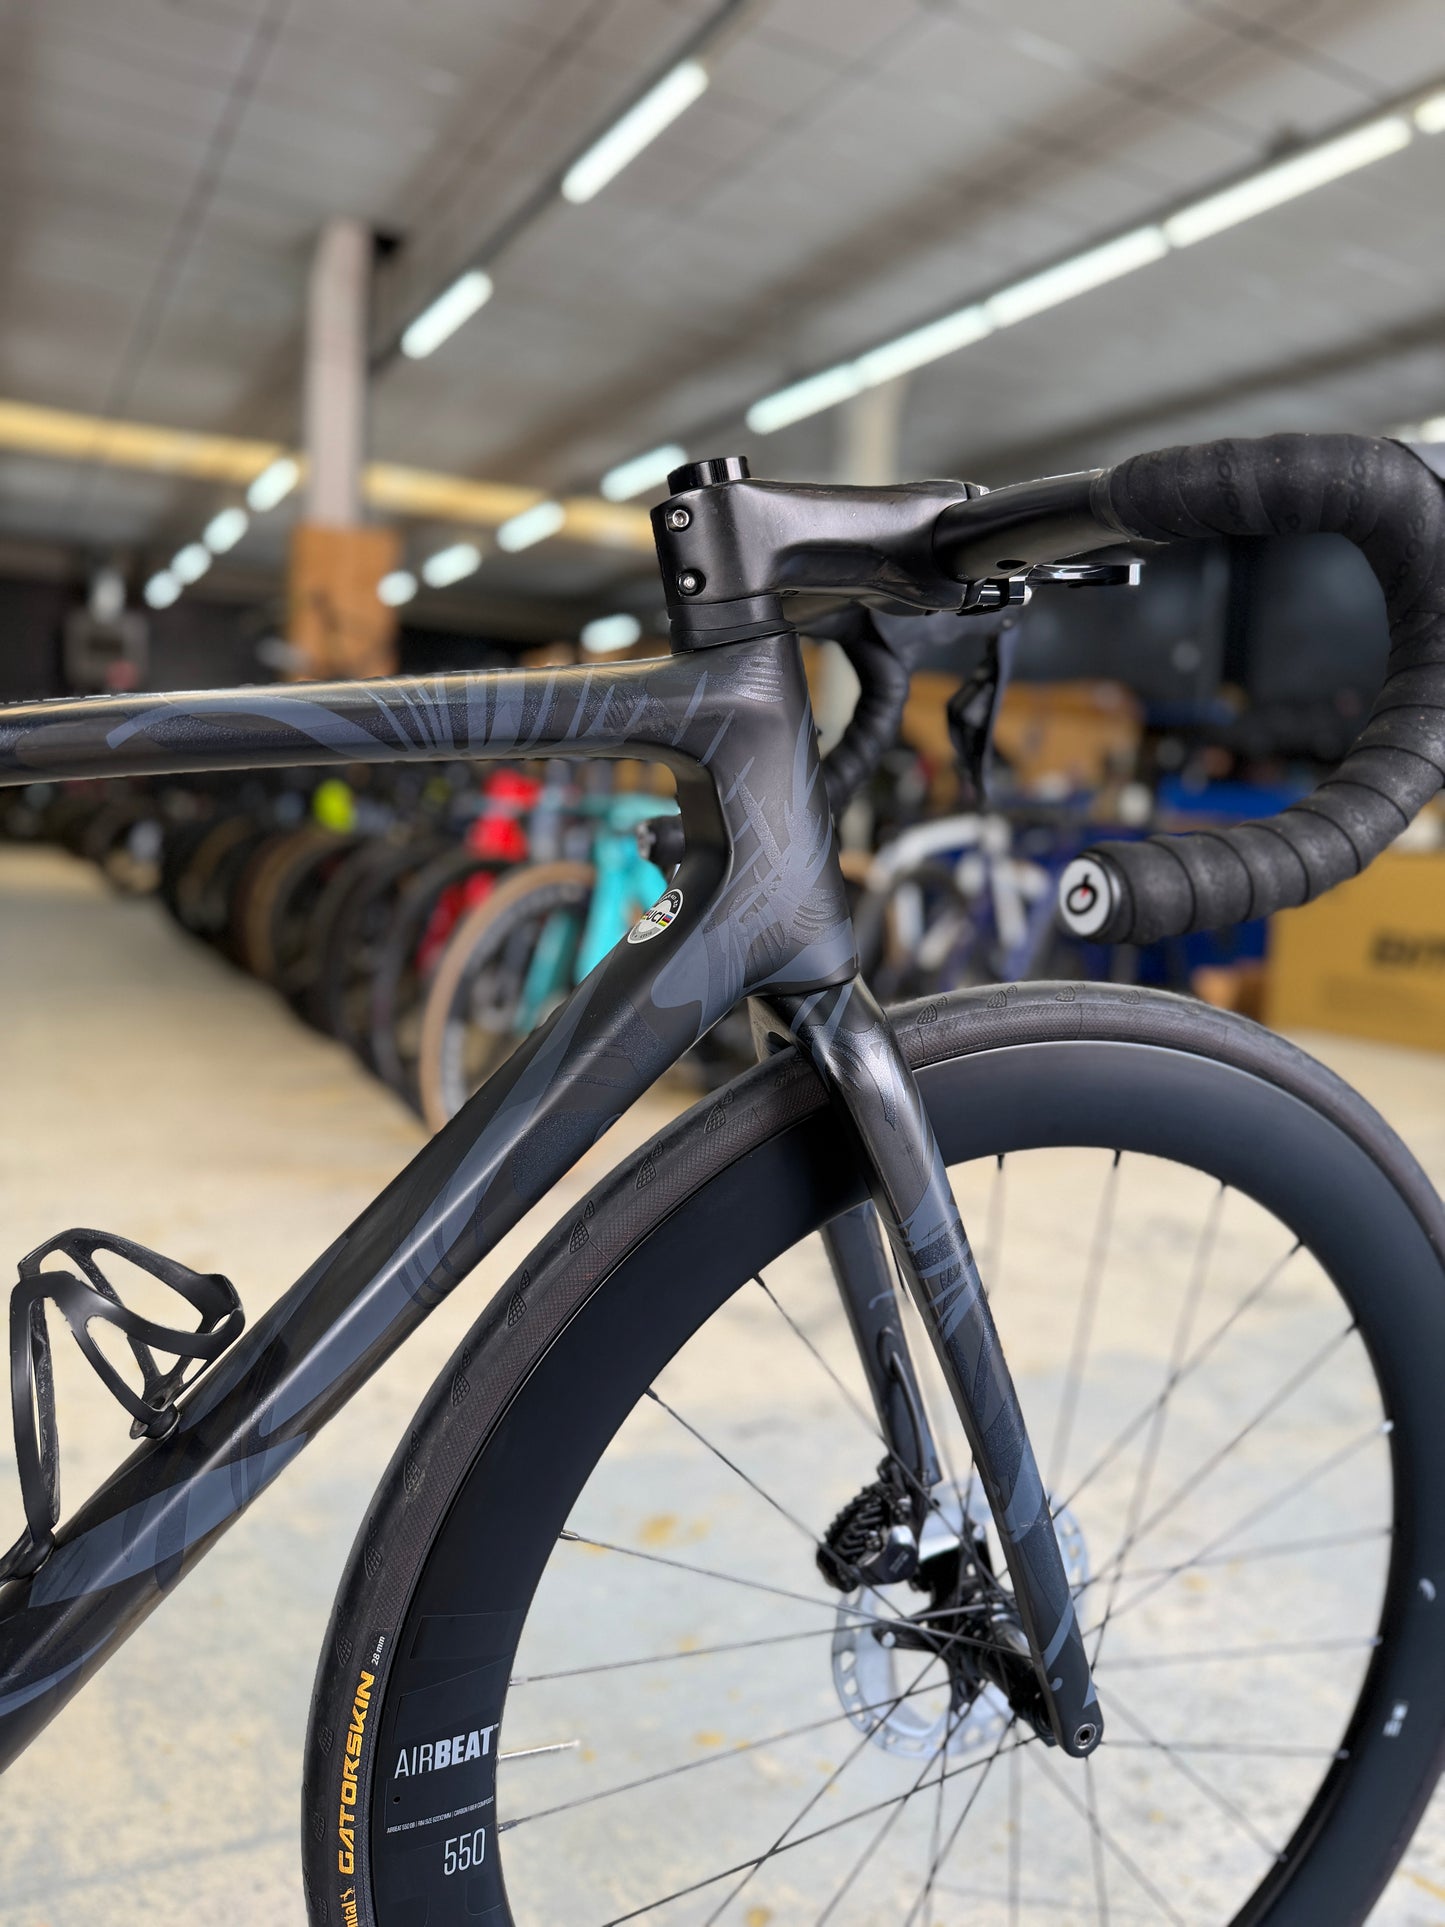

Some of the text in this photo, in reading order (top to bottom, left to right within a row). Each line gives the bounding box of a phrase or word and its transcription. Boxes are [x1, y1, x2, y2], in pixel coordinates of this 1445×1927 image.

[646, 910, 666, 924] UCI
[371, 1635, 386, 1667] 28 mm
[338, 1670, 376, 1875] GATORSKIN
[443, 1827, 486, 1876] 550
